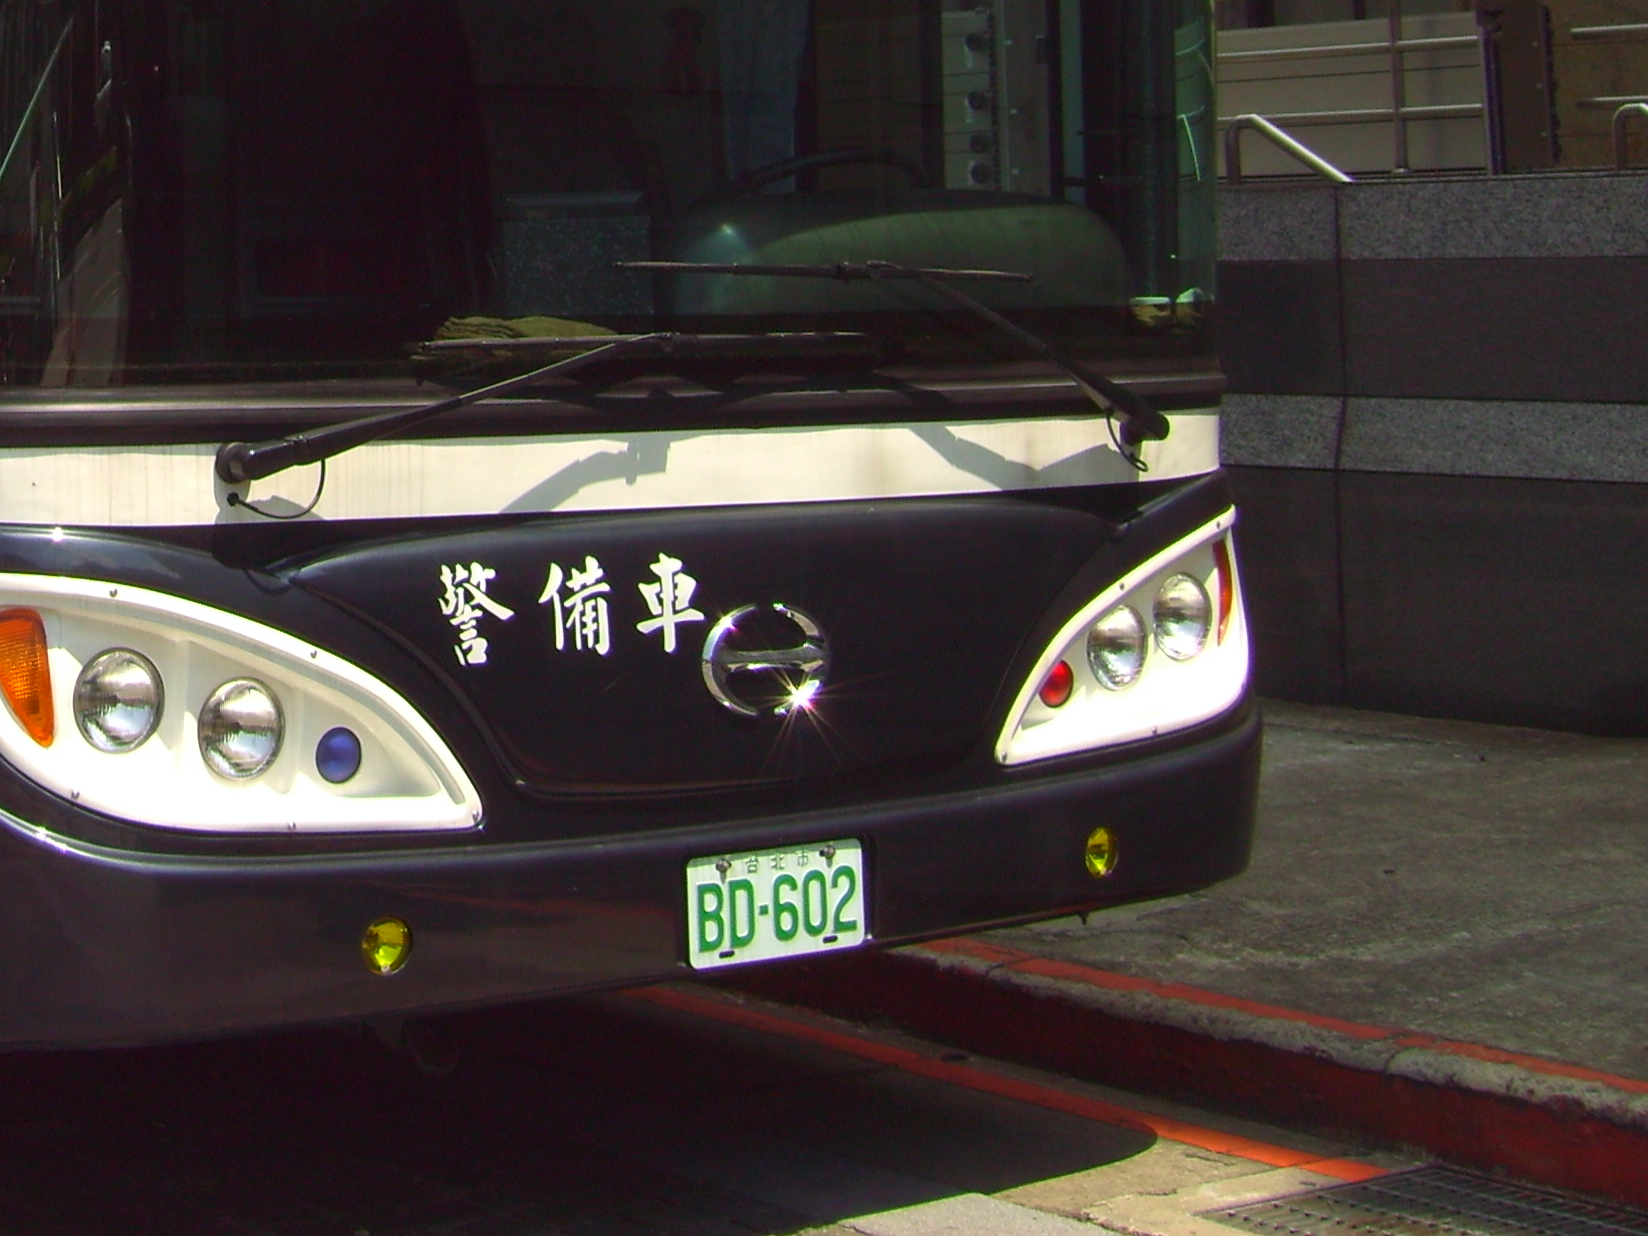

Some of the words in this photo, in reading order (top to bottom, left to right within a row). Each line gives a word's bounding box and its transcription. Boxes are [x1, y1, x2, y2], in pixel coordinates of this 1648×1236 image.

[438, 552, 706, 666] 警備車
[744, 849, 809, 874] 台北市
[696, 865, 858, 953] BD-602
